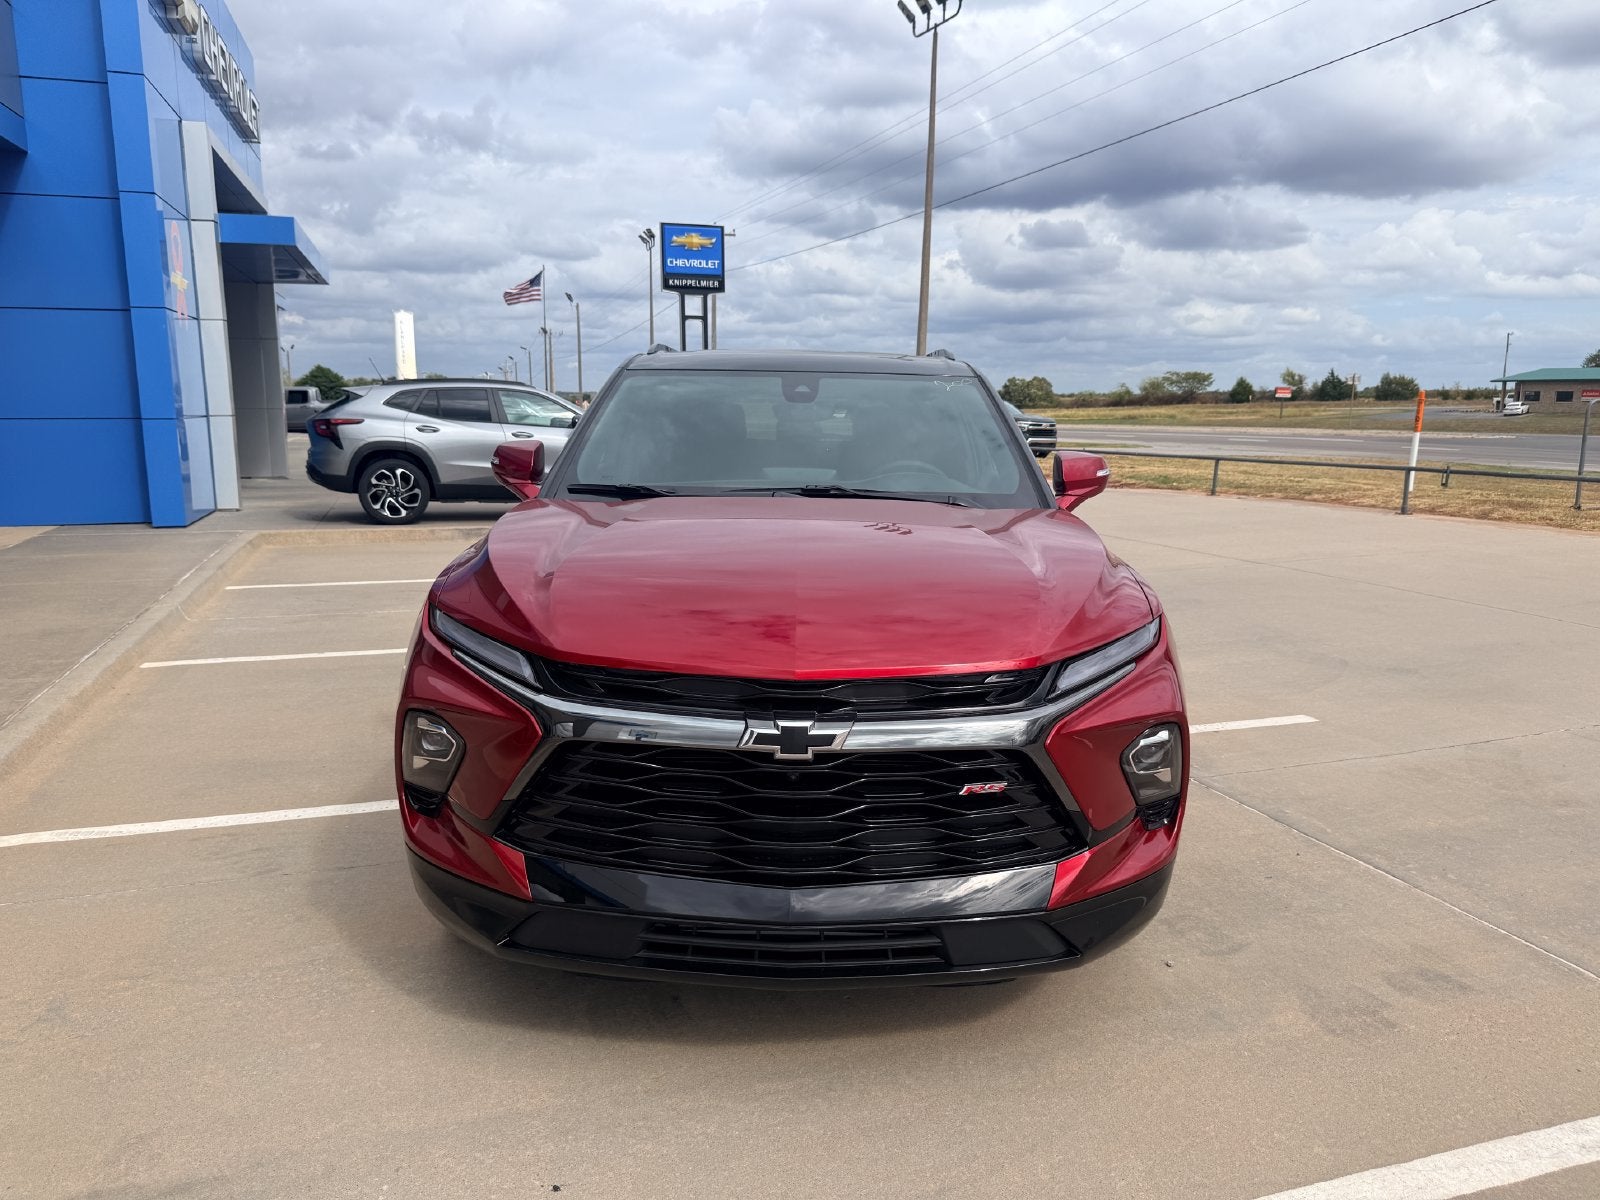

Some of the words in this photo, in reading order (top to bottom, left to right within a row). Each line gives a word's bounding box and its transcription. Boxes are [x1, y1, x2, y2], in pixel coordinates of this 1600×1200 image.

[667, 258, 720, 269] CHEVROLET
[668, 279, 719, 288] KNIPPELMIER
[959, 781, 1007, 796] RS
